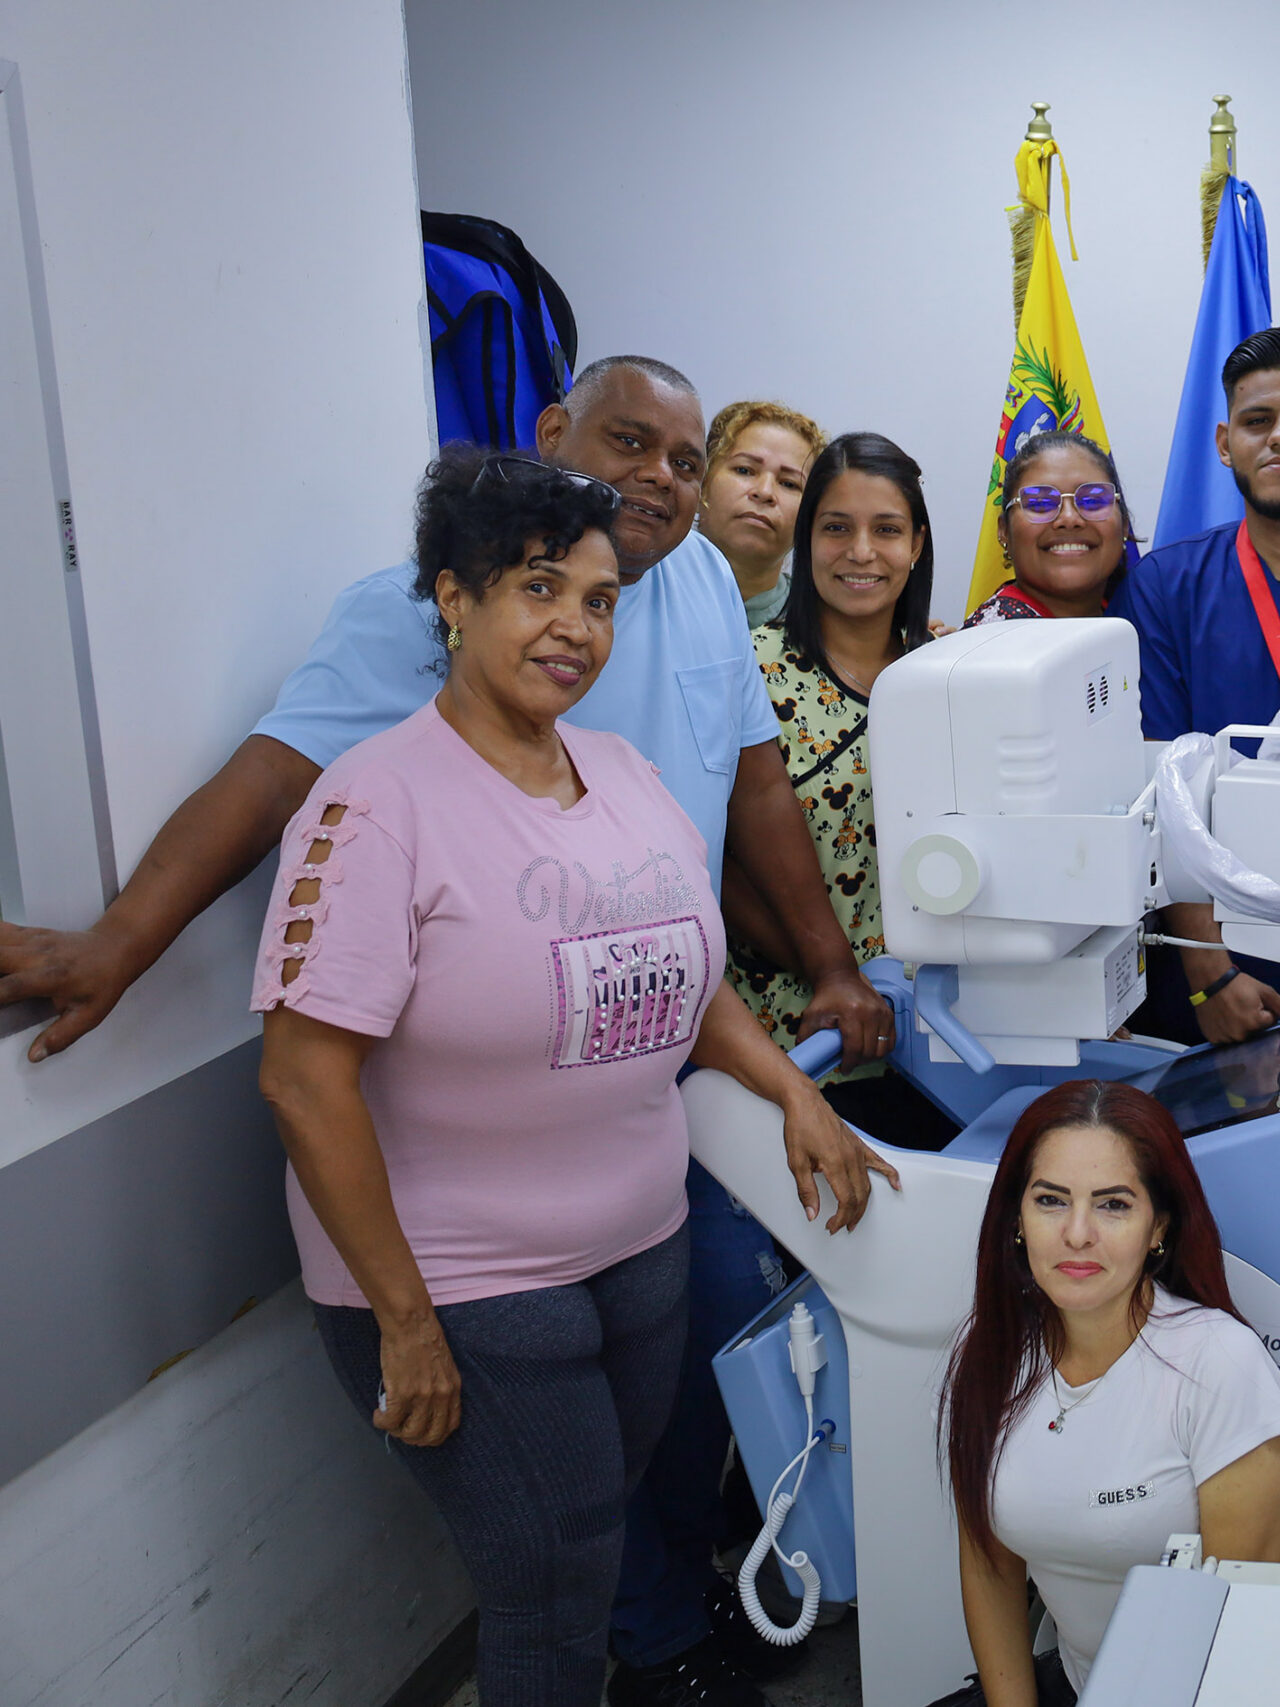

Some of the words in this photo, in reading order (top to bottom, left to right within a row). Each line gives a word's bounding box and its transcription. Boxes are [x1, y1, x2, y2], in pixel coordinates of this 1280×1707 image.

[63, 502, 72, 525] BAR
[68, 544, 78, 567] RAY
[1097, 1485, 1147, 1505] GUESS
